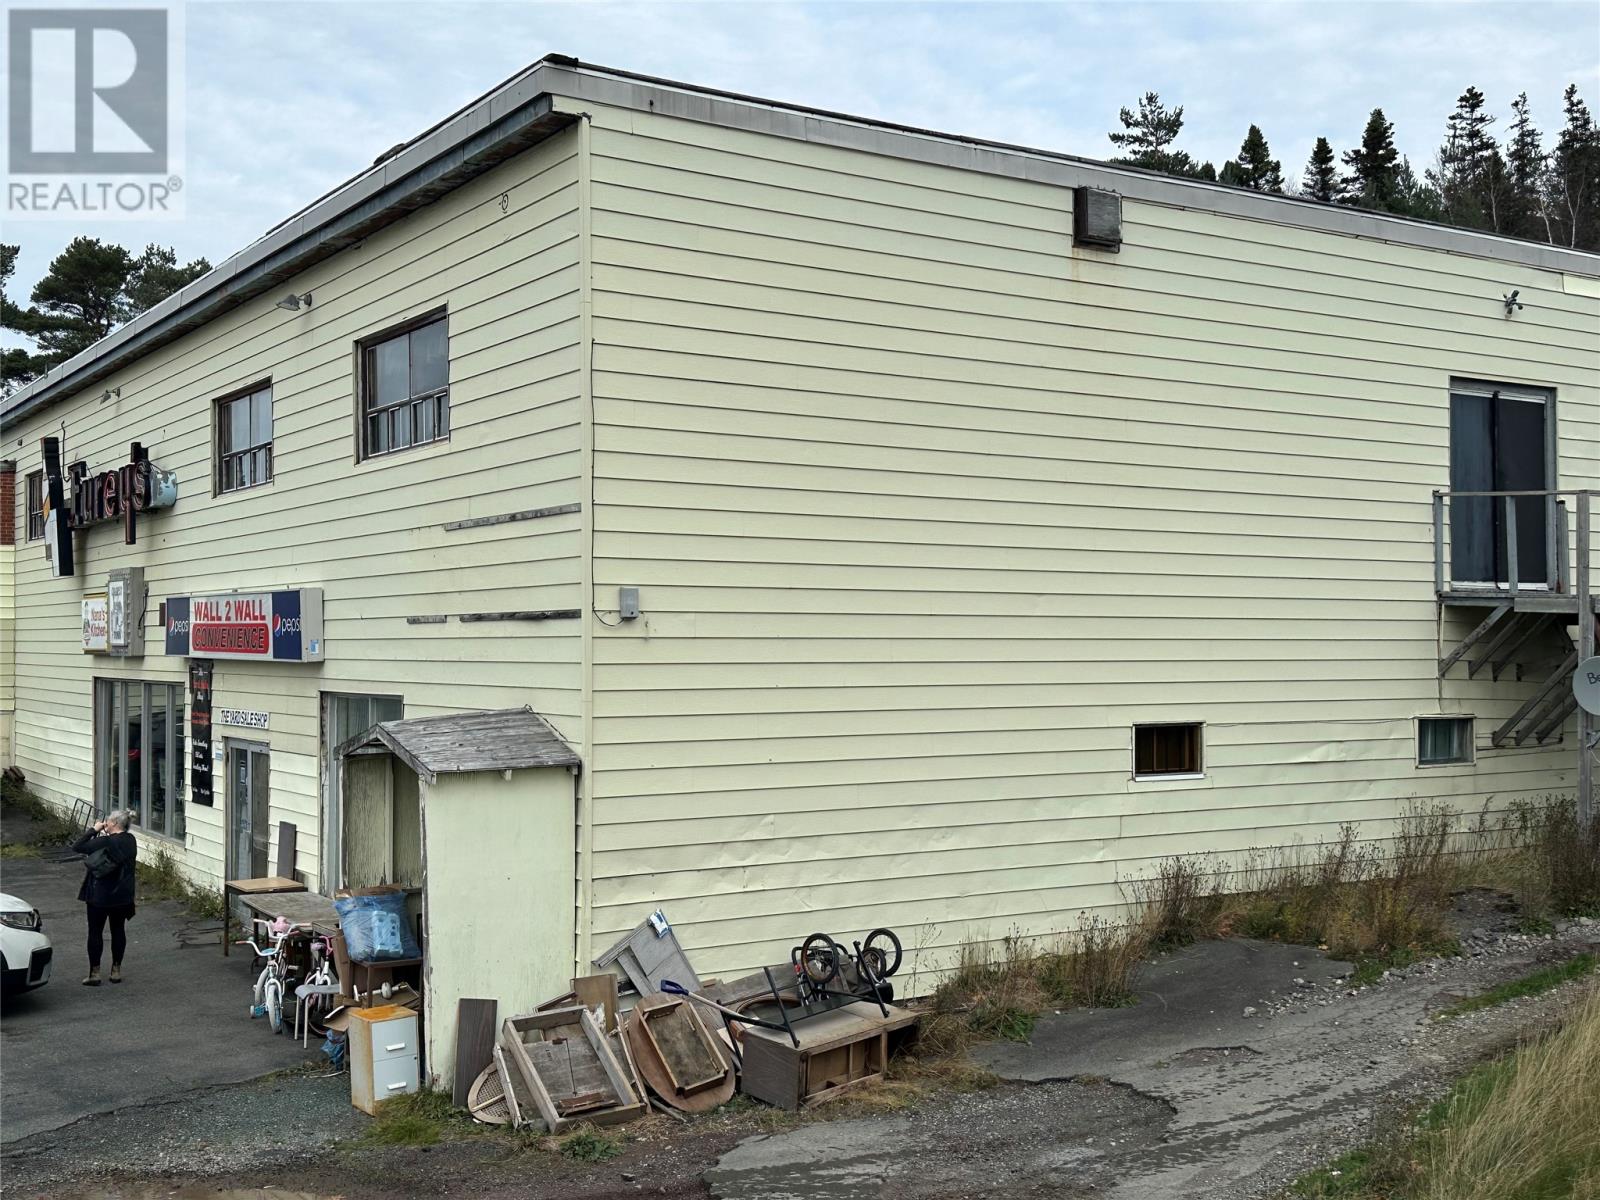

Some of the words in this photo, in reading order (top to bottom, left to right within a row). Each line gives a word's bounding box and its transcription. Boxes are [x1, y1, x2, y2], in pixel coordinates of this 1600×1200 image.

[194, 602, 222, 622] WALL
[225, 602, 232, 621] 2
[234, 600, 266, 621] WALL
[91, 623, 106, 637] Kitchen
[174, 618, 189, 635] peps
[194, 627, 265, 649] CONVENIENCE
[221, 710, 230, 723] THE
[241, 711, 253, 725] SALE
[253, 712, 267, 727] SHOP
